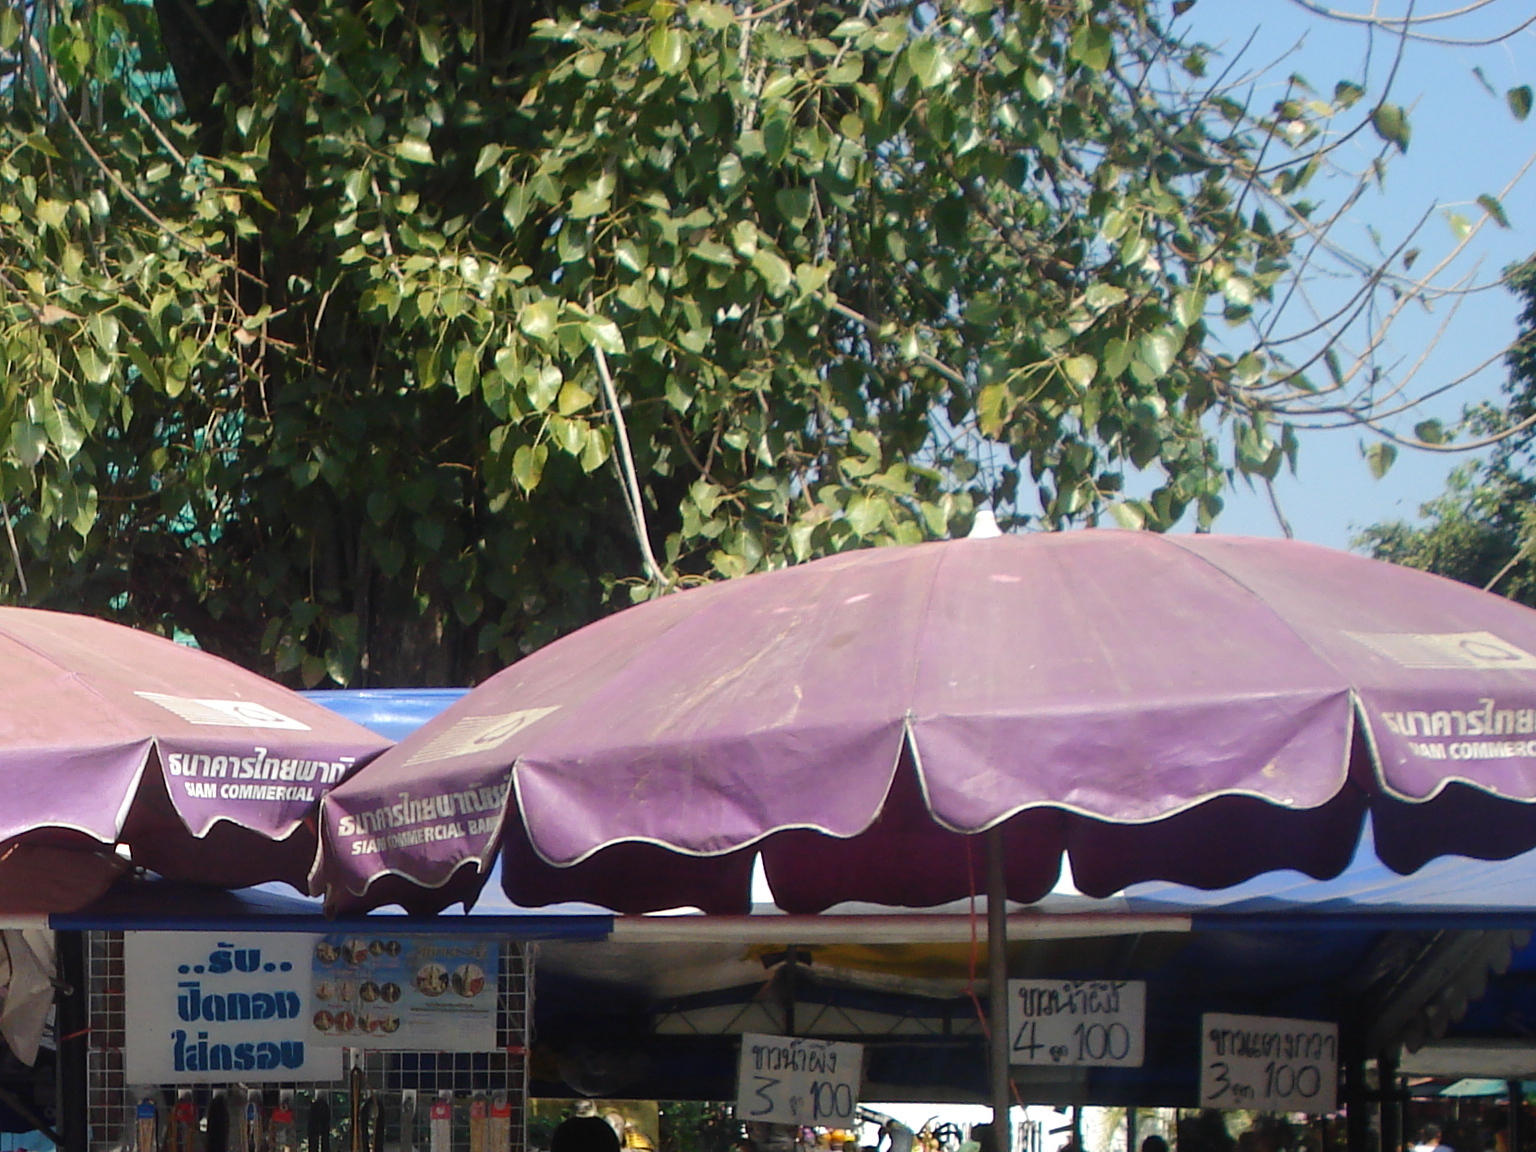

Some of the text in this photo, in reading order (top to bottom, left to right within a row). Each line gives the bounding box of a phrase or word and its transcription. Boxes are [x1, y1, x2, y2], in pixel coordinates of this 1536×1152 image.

[184, 782, 217, 799] SIAM
[220, 784, 314, 802] COMMERCIAL
[387, 823, 465, 850] COMMERCIAL
[1013, 1021, 1045, 1060] 4
[1073, 1022, 1131, 1061] 100
[749, 1075, 781, 1116] 3
[809, 1081, 853, 1121] 100
[1207, 1062, 1231, 1100] 3
[1265, 1060, 1322, 1098] 100
